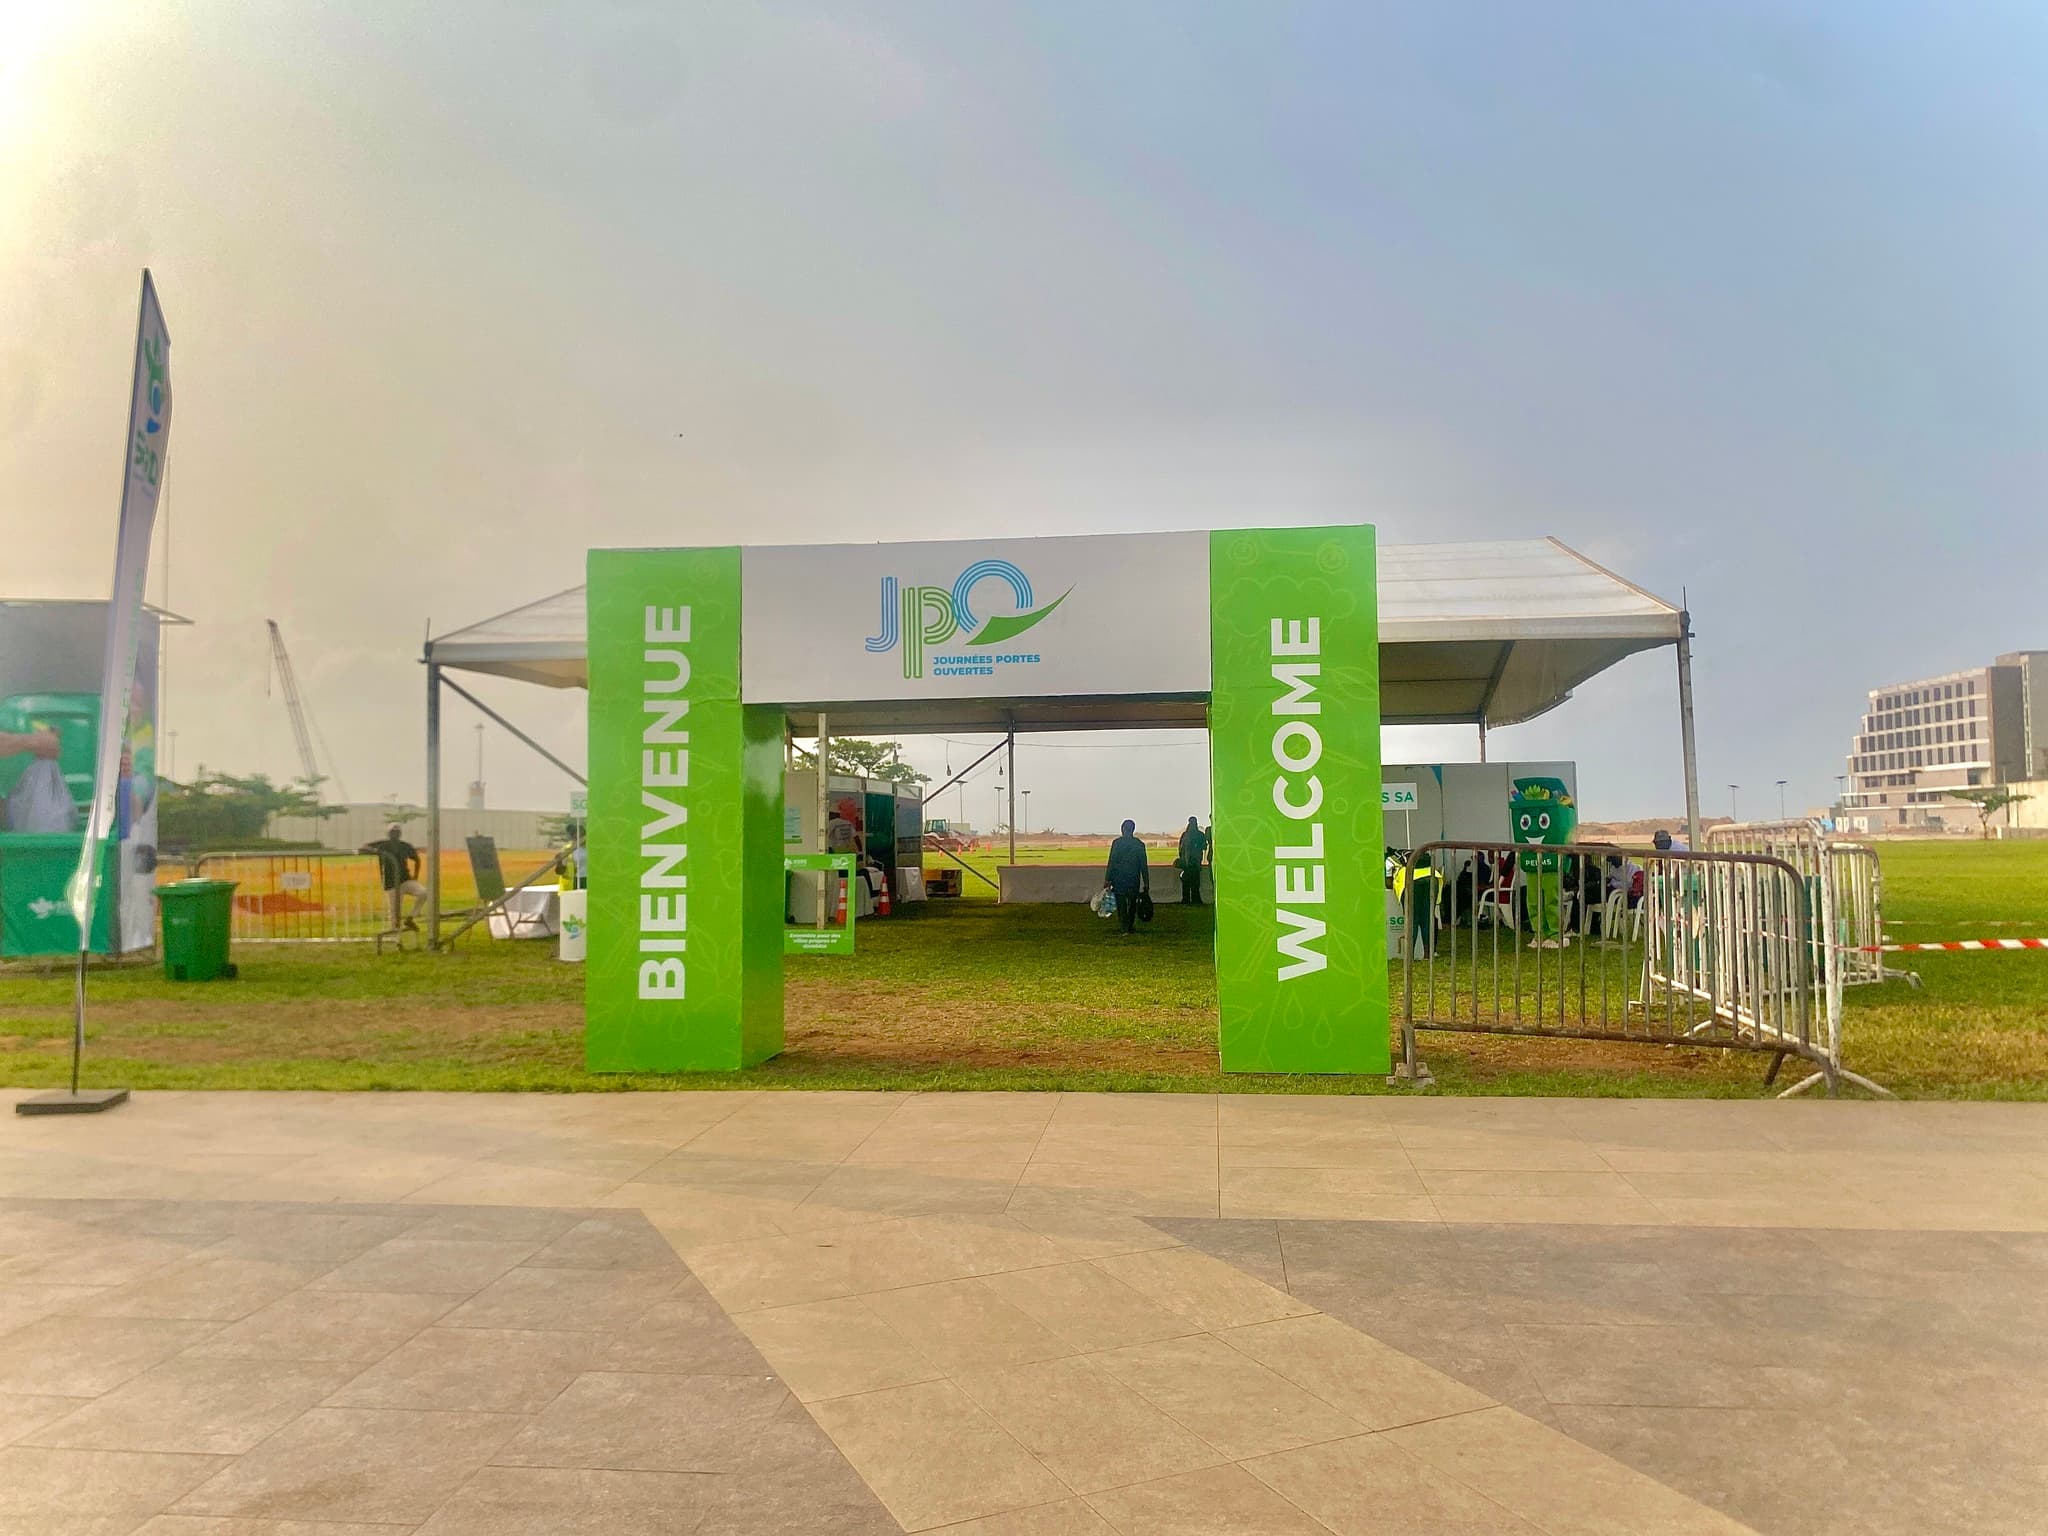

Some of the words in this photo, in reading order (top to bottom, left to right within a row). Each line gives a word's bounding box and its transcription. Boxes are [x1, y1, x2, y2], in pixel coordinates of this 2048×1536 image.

[865, 559, 1076, 679] JPO
[933, 653, 993, 665] JOURNÉES
[995, 654, 1041, 664] PORTES
[933, 667, 993, 676] OUVERTES
[638, 605, 692, 1000] BIENVENUE
[1270, 617, 1328, 983] WELCOME
[1394, 791, 1415, 803] SA
